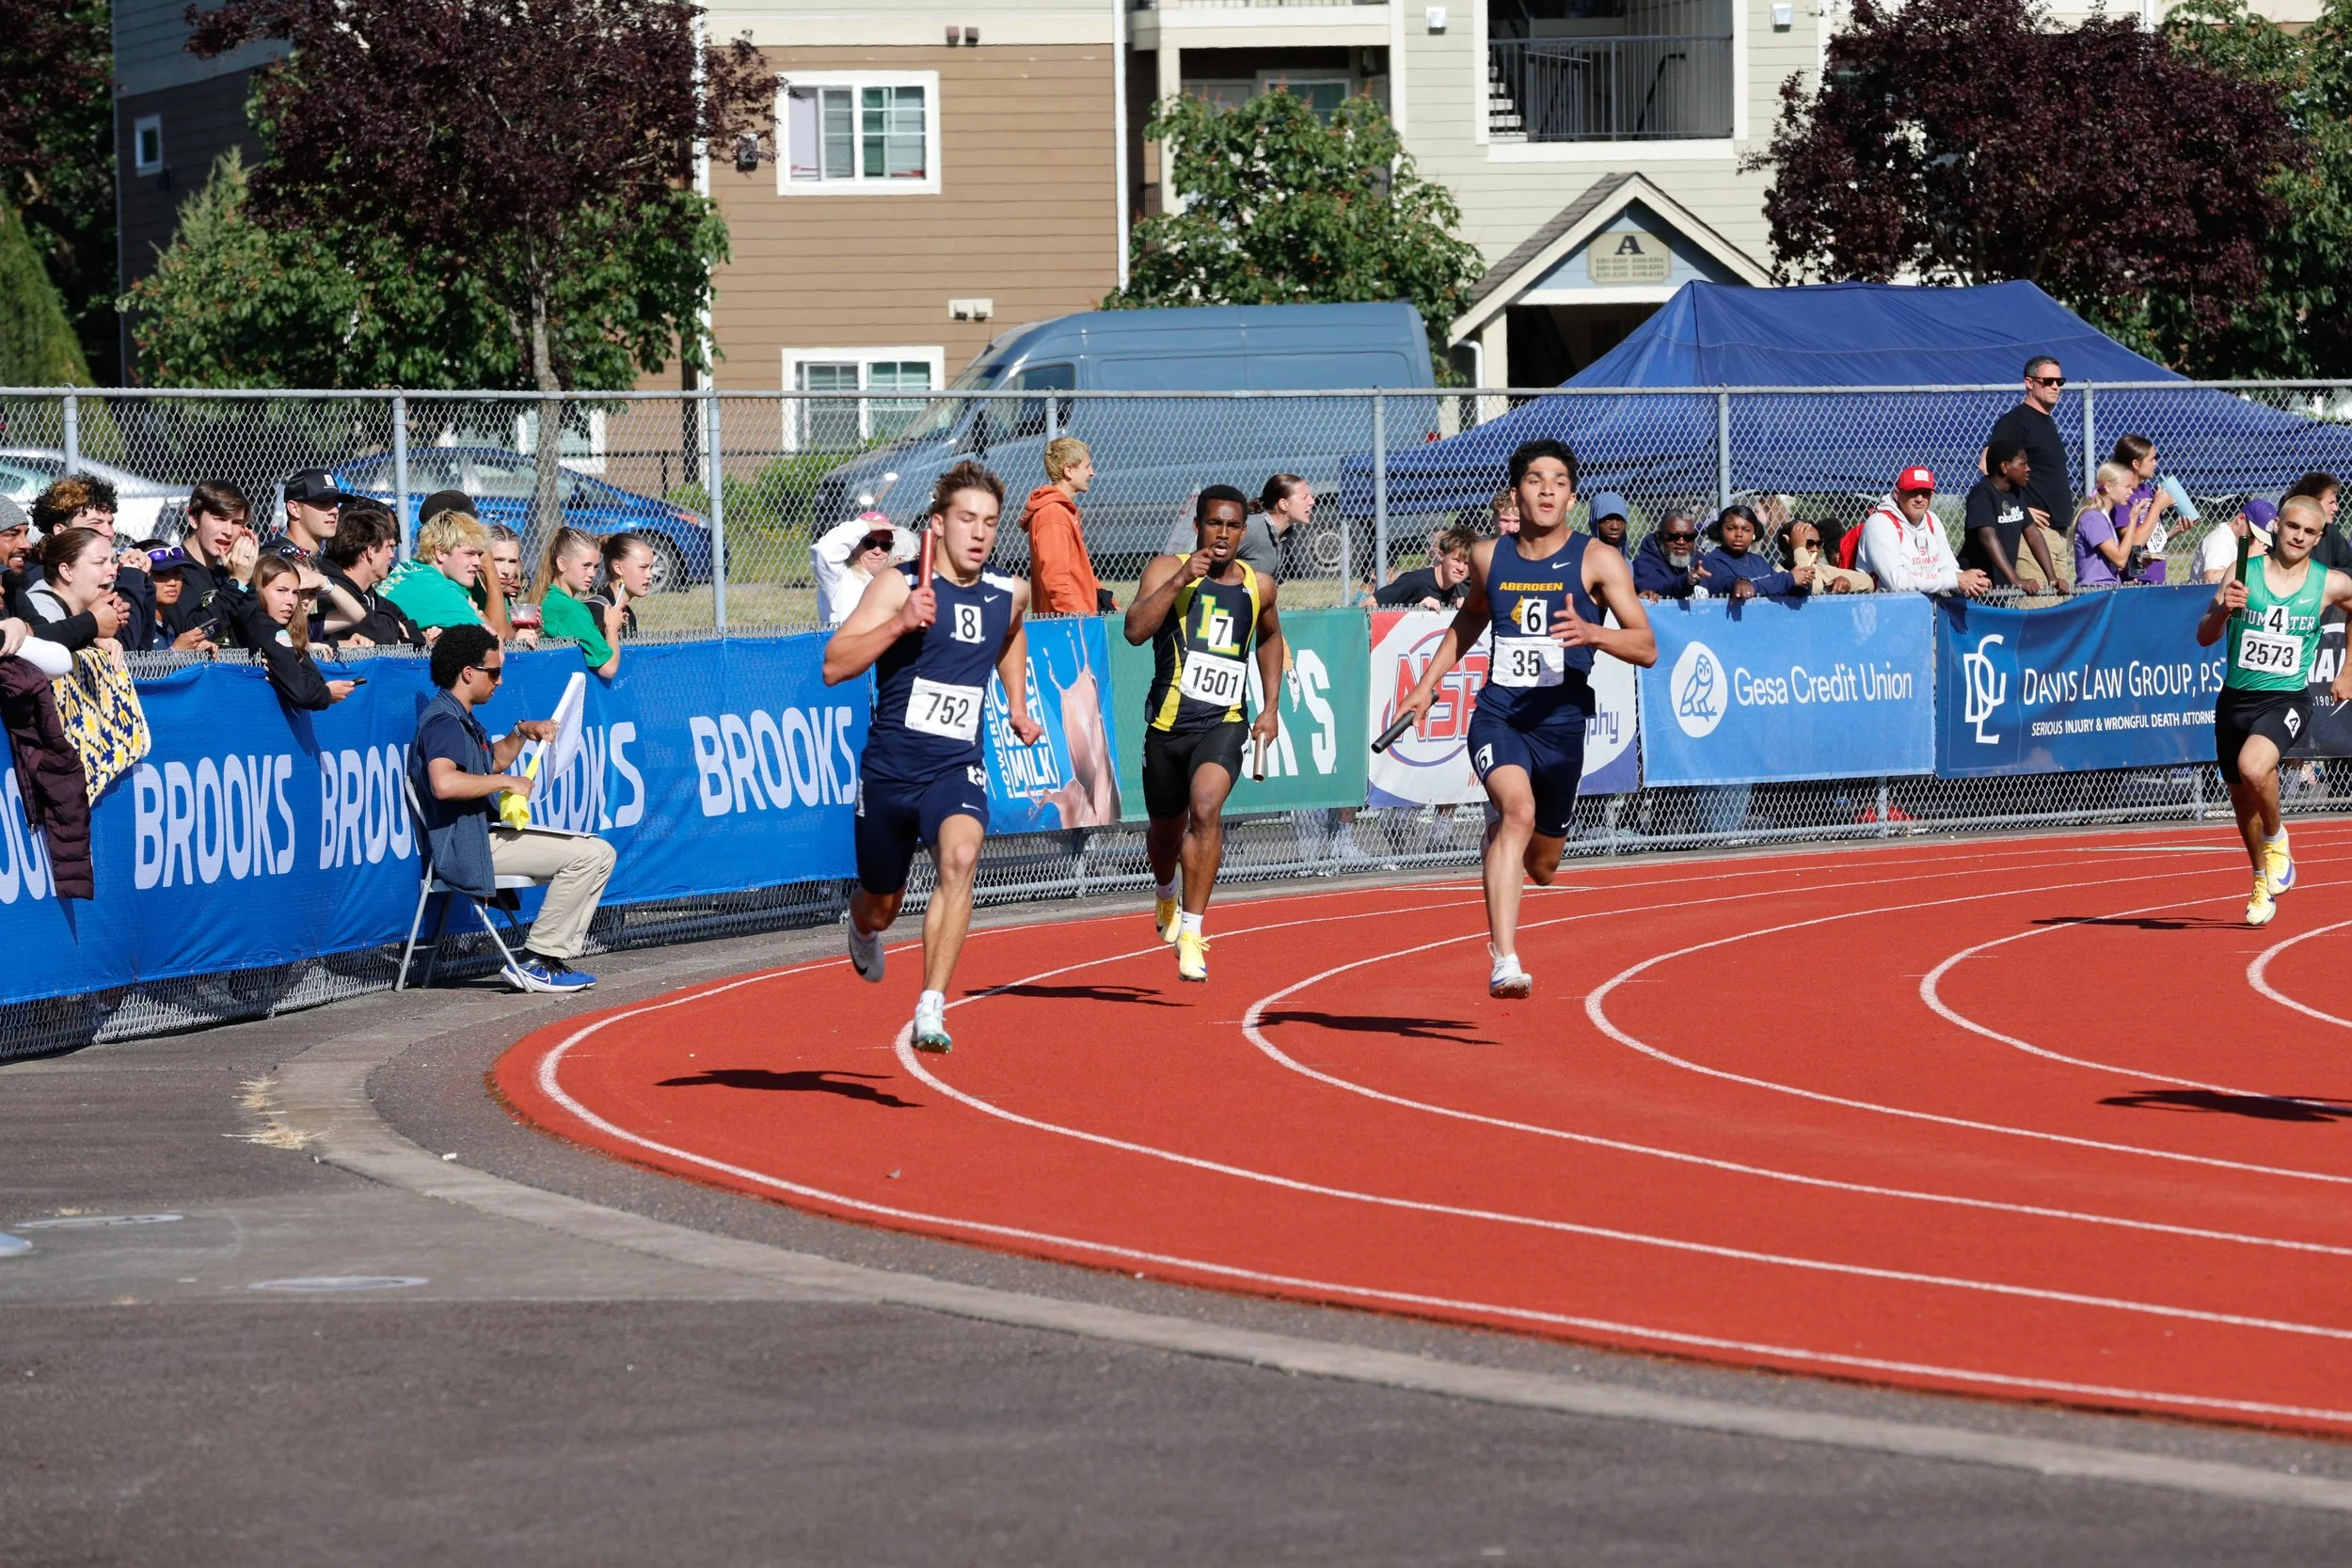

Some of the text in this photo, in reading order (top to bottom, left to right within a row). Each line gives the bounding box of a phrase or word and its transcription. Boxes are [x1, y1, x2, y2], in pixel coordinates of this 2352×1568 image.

[1614, 235, 1645, 255] A
[1499, 581, 1564, 592] ABERDEEN
[961, 608, 977, 640] 8
[1215, 618, 1229, 646] 7
[1527, 602, 1542, 633] 6
[2241, 608, 2316, 631] TUMTER
[2268, 608, 2283, 632] 4
[1512, 649, 1541, 677] 35
[2245, 641, 2295, 668] 2573
[1193, 665, 1239, 699] 1501
[1734, 661, 1913, 706] Gesa Credit Union
[2024, 668, 2078, 705] DAVIS
[2082, 664, 2123, 701] LAW
[2128, 660, 2197, 698] GROUP,
[926, 691, 970, 729] 752
[2031, 710, 2217, 736] SERIOUS INJURY & WRONGFUL DEATH ATTORNE
[2289, 717, 2299, 732] 4
[689, 706, 857, 817] BROOKS
[1008, 746, 1057, 787] MILK
[1478, 748, 1488, 773] 6
[319, 743, 421, 870] BROO
[133, 753, 295, 890] BROOKS
